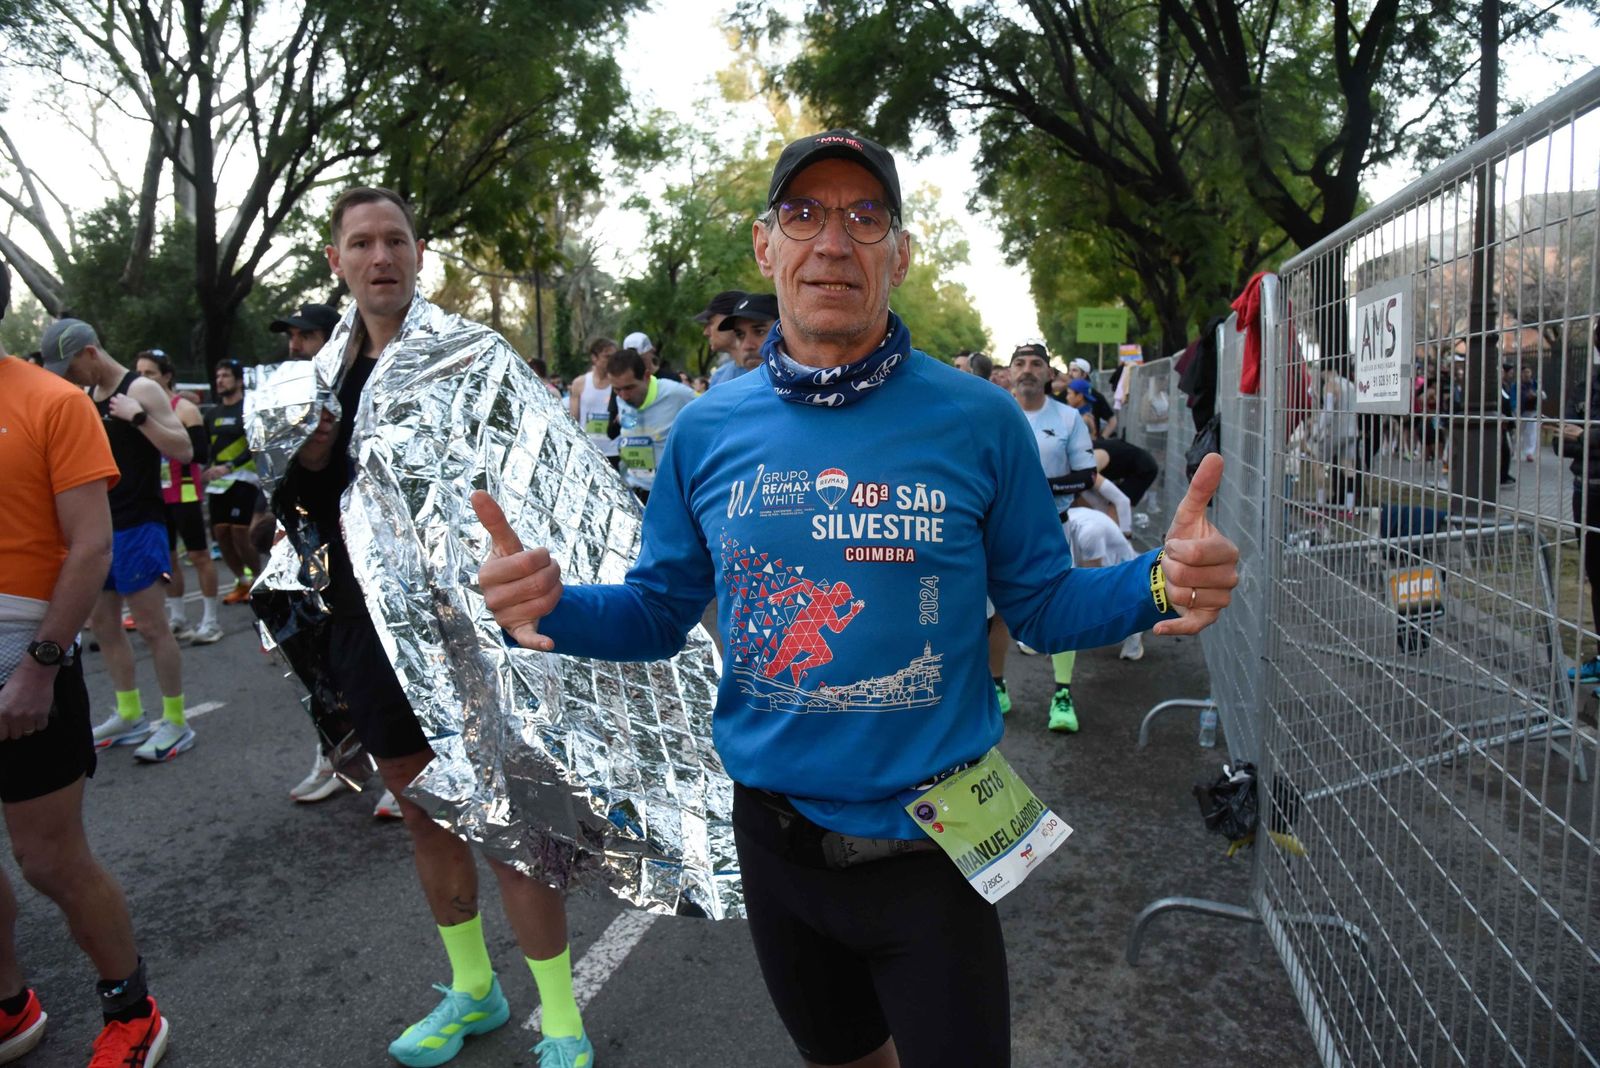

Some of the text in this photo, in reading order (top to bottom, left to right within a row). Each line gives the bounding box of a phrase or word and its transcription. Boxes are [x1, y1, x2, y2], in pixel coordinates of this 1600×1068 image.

[1361, 298, 1397, 362] AMS
[762, 470, 809, 484] GRUPO
[762, 481, 812, 495] RE/MAX
[820, 478, 844, 486] RE/MAX
[762, 493, 805, 506] WHITE
[896, 482, 947, 514] SÃO
[811, 513, 944, 543] SILVESTRE
[845, 547, 915, 562] COIMBRA
[919, 575, 940, 625] 2024
[971, 770, 1005, 805] 2018
[956, 828, 1015, 876] MANUEL
